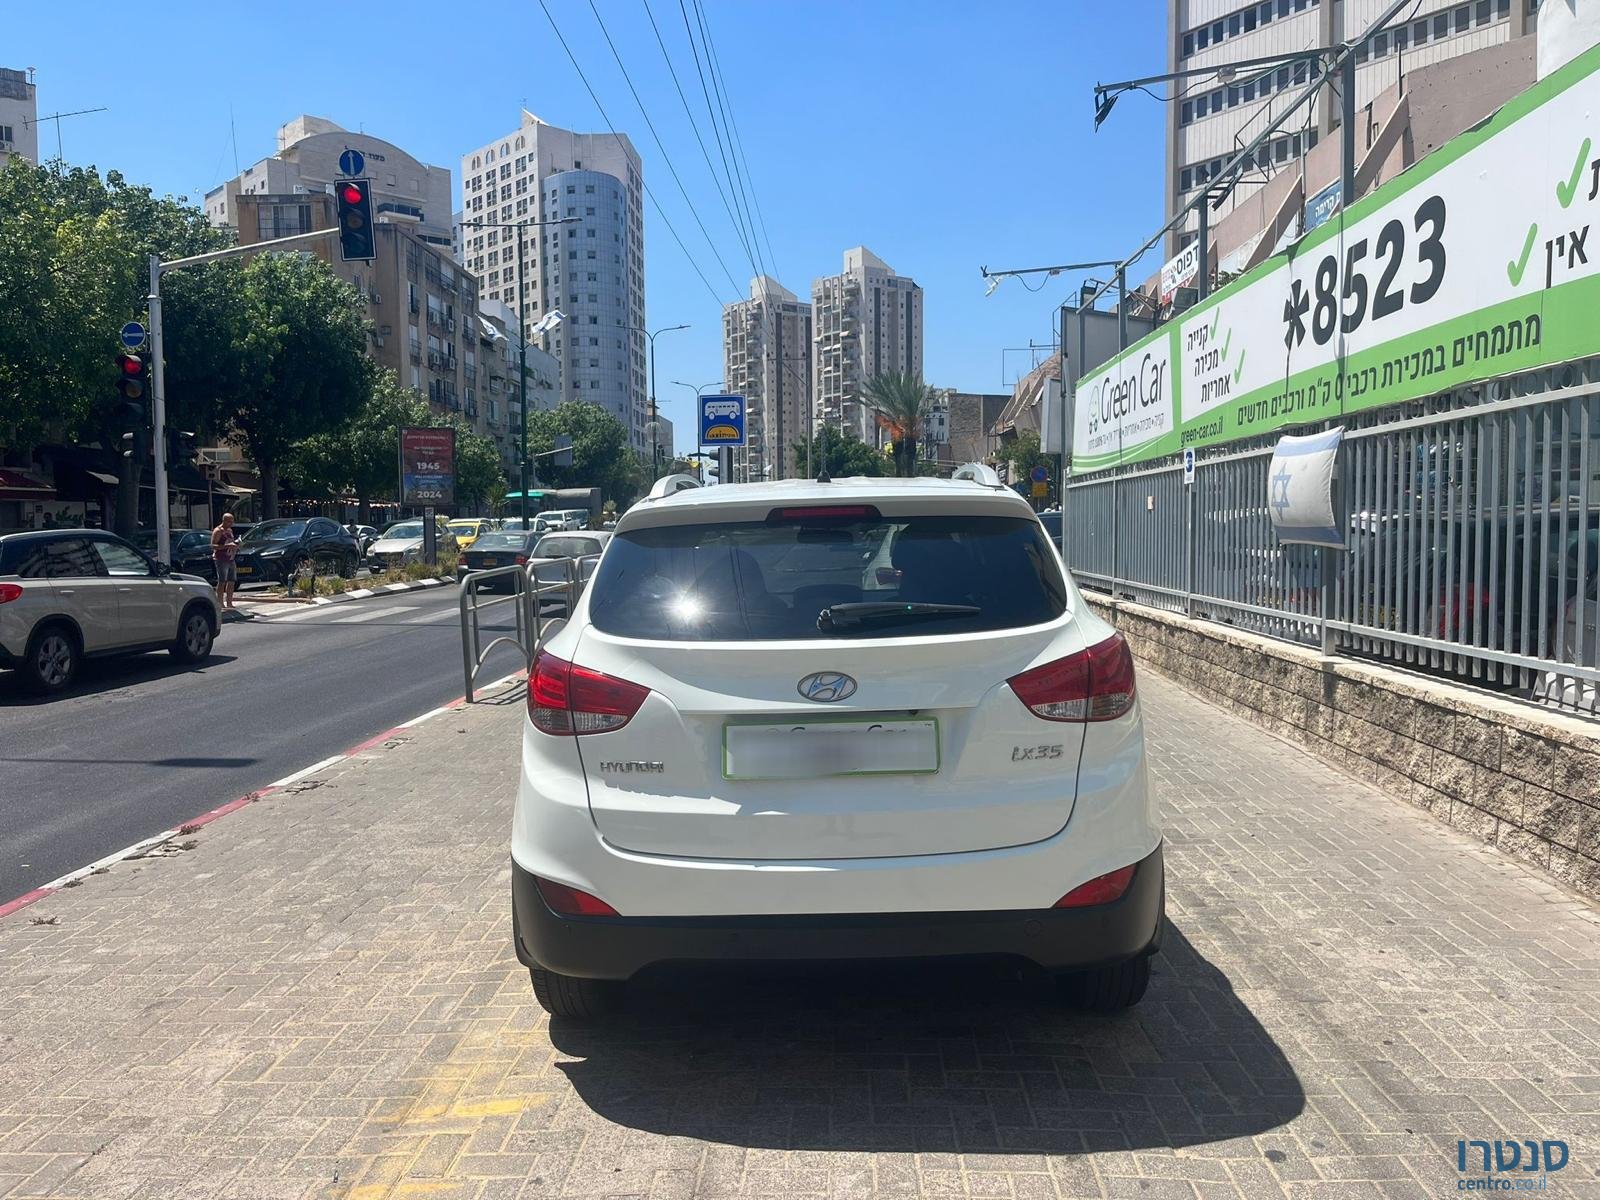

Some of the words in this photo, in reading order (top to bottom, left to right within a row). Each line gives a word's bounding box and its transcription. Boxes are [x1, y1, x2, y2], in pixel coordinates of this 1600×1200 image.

[1545, 225, 1590, 289] אין
[1187, 324, 1209, 352] קנייה
[1452, 313, 1541, 368] מתמחים
[1194, 348, 1219, 377] מכירה
[1381, 344, 1446, 389] במכירת
[1101, 375, 1136, 424] Green
[1140, 353, 1166, 407] Car
[1200, 373, 1231, 403] אחריות
[1271, 388, 1305, 418] ורכבים
[1237, 400, 1268, 426] חדשים
[1180, 415, 1224, 447] green-car.co.il
[416, 462, 440, 470] 1945
[417, 490, 442, 499] 2024
